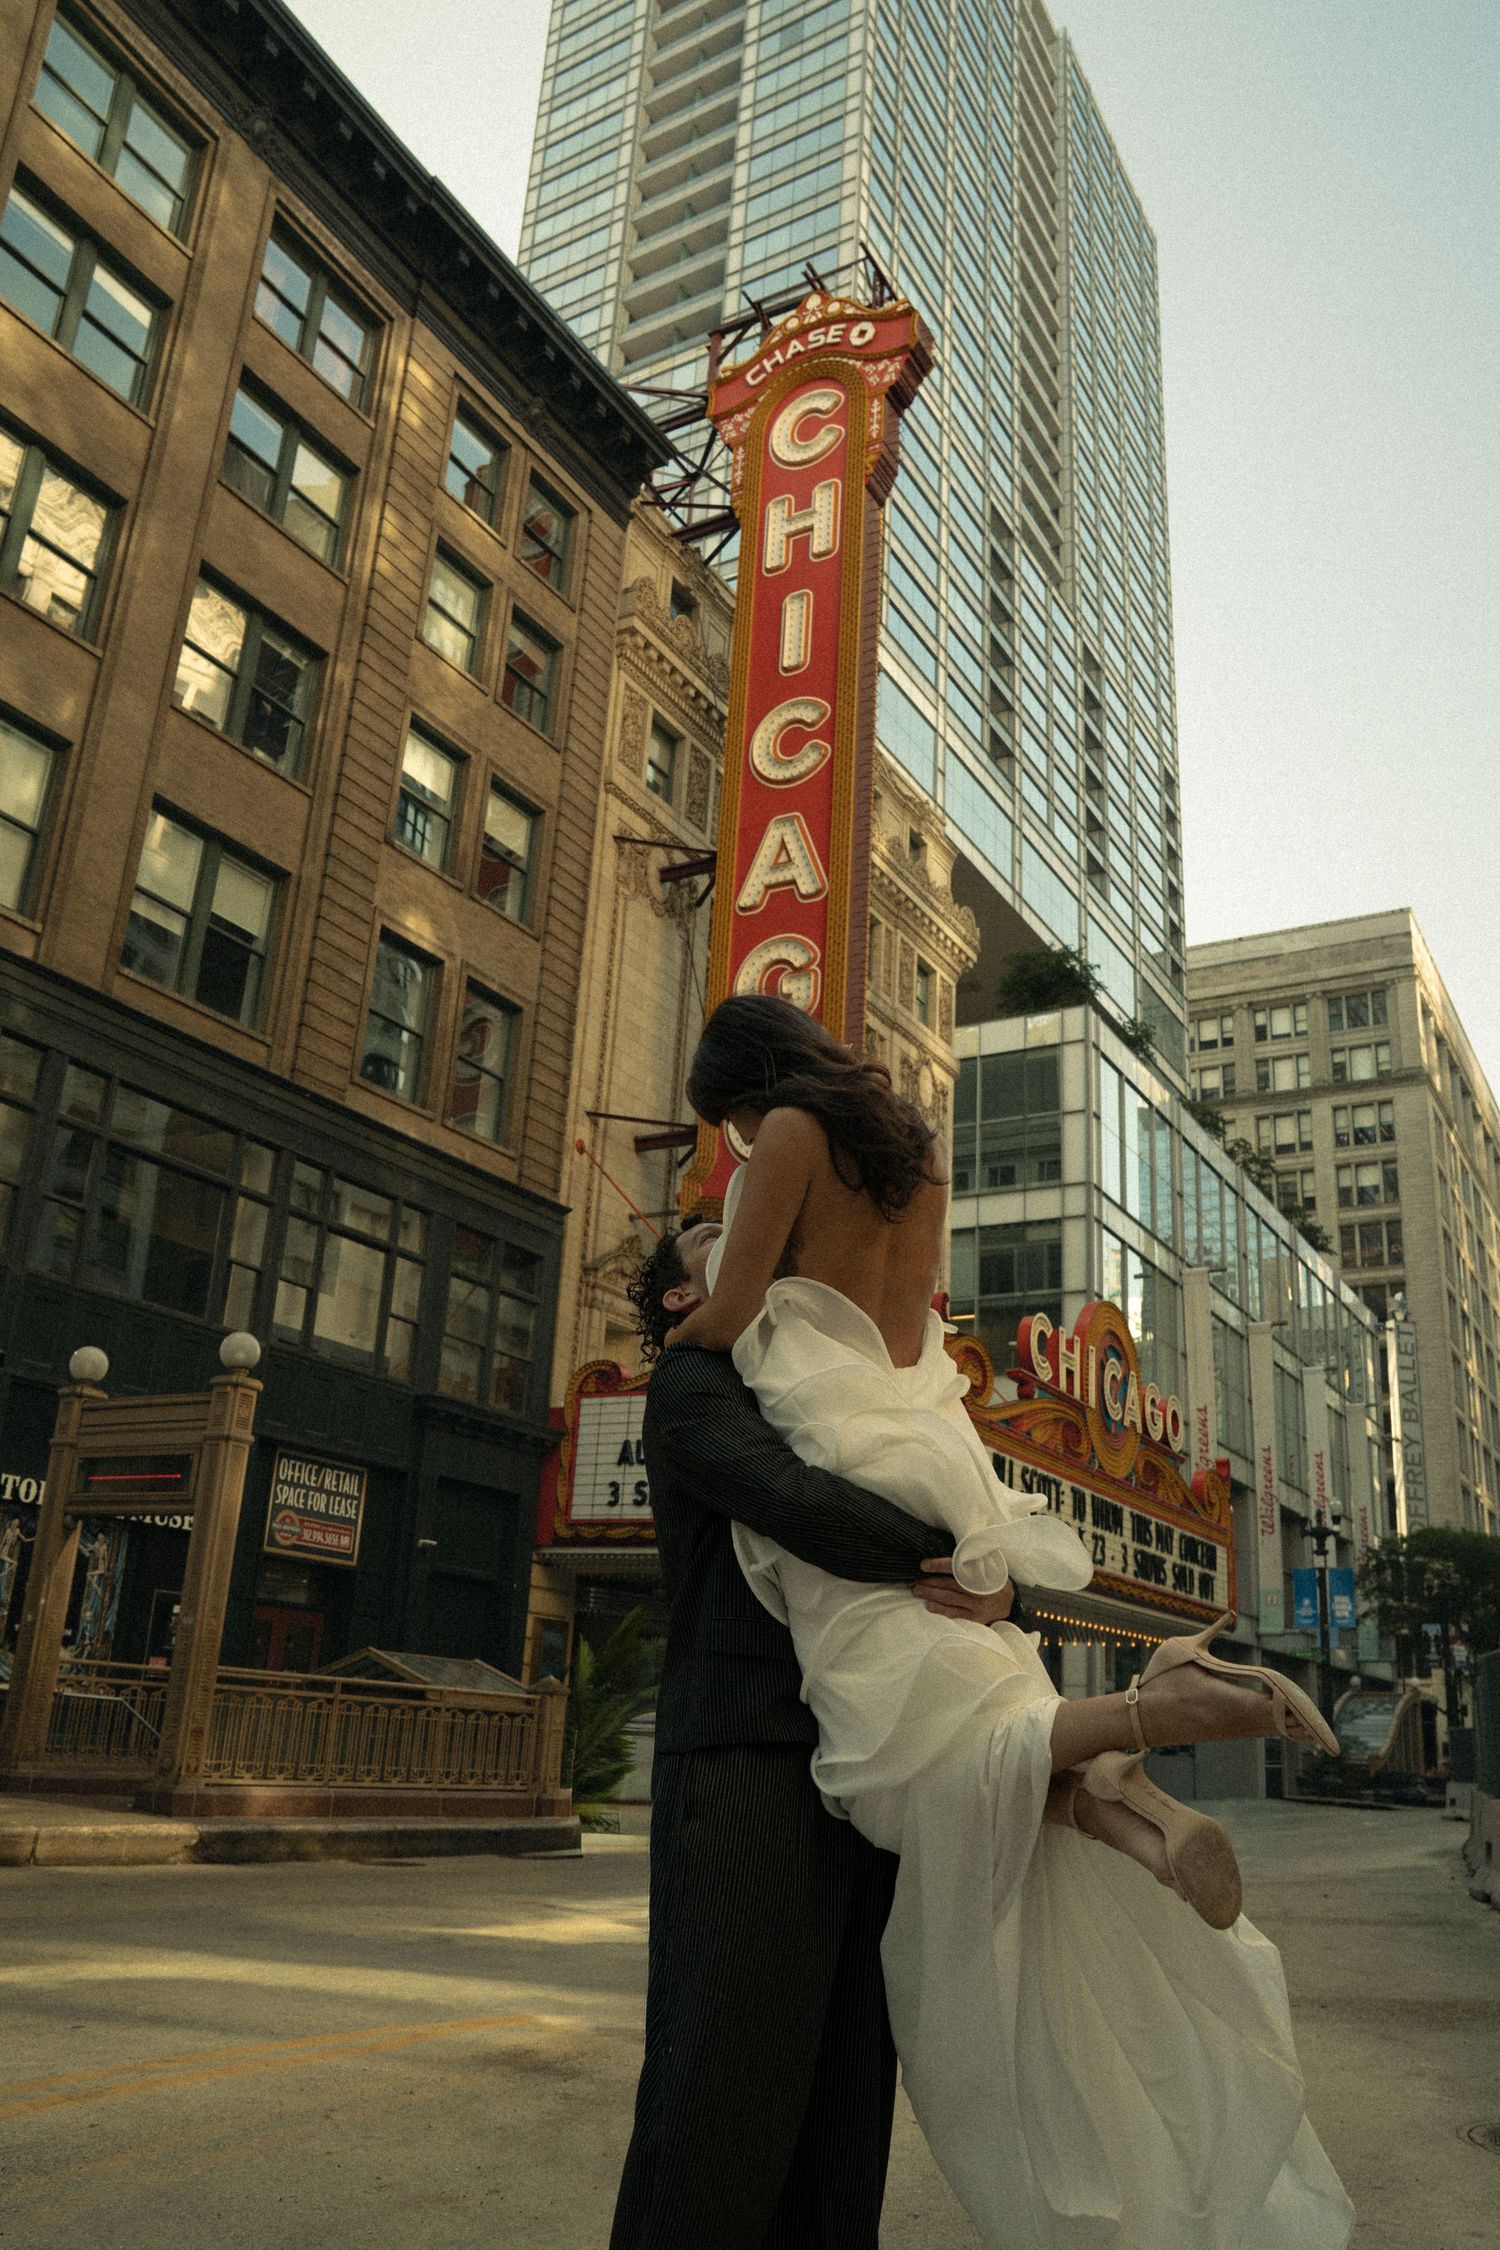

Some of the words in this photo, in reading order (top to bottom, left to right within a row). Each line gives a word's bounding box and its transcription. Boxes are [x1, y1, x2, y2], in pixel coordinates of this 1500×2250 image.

[745, 323, 847, 387] CHASE
[724, 387, 846, 1165] CHICAG
[1029, 1311, 1184, 1453] CHICAGO
[1397, 1324, 1419, 1424] BALLET
[275, 1483, 306, 1510] SPACE
[307, 1490, 327, 1514] FOR
[328, 1494, 359, 1520] LEASE
[279, 1457, 360, 1497] OFFICE/RETAIL
[607, 1480, 620, 1507] 3
[633, 1480, 651, 1507] S
[1402, 1433, 1426, 1536] OFFREY
[1070, 1485, 1087, 1523] TO
[1091, 1493, 1124, 1538] WHOM
[1130, 1510, 1154, 1548] THIS
[1154, 1520, 1175, 1556] MAY
[1178, 1532, 1218, 1572] CONCERN
[1120, 1542, 1128, 1574] 3
[1133, 1547, 1168, 1586] SHOWS
[1172, 1561, 1195, 1597] SOLD
[1198, 1571, 1216, 1603] OUT
